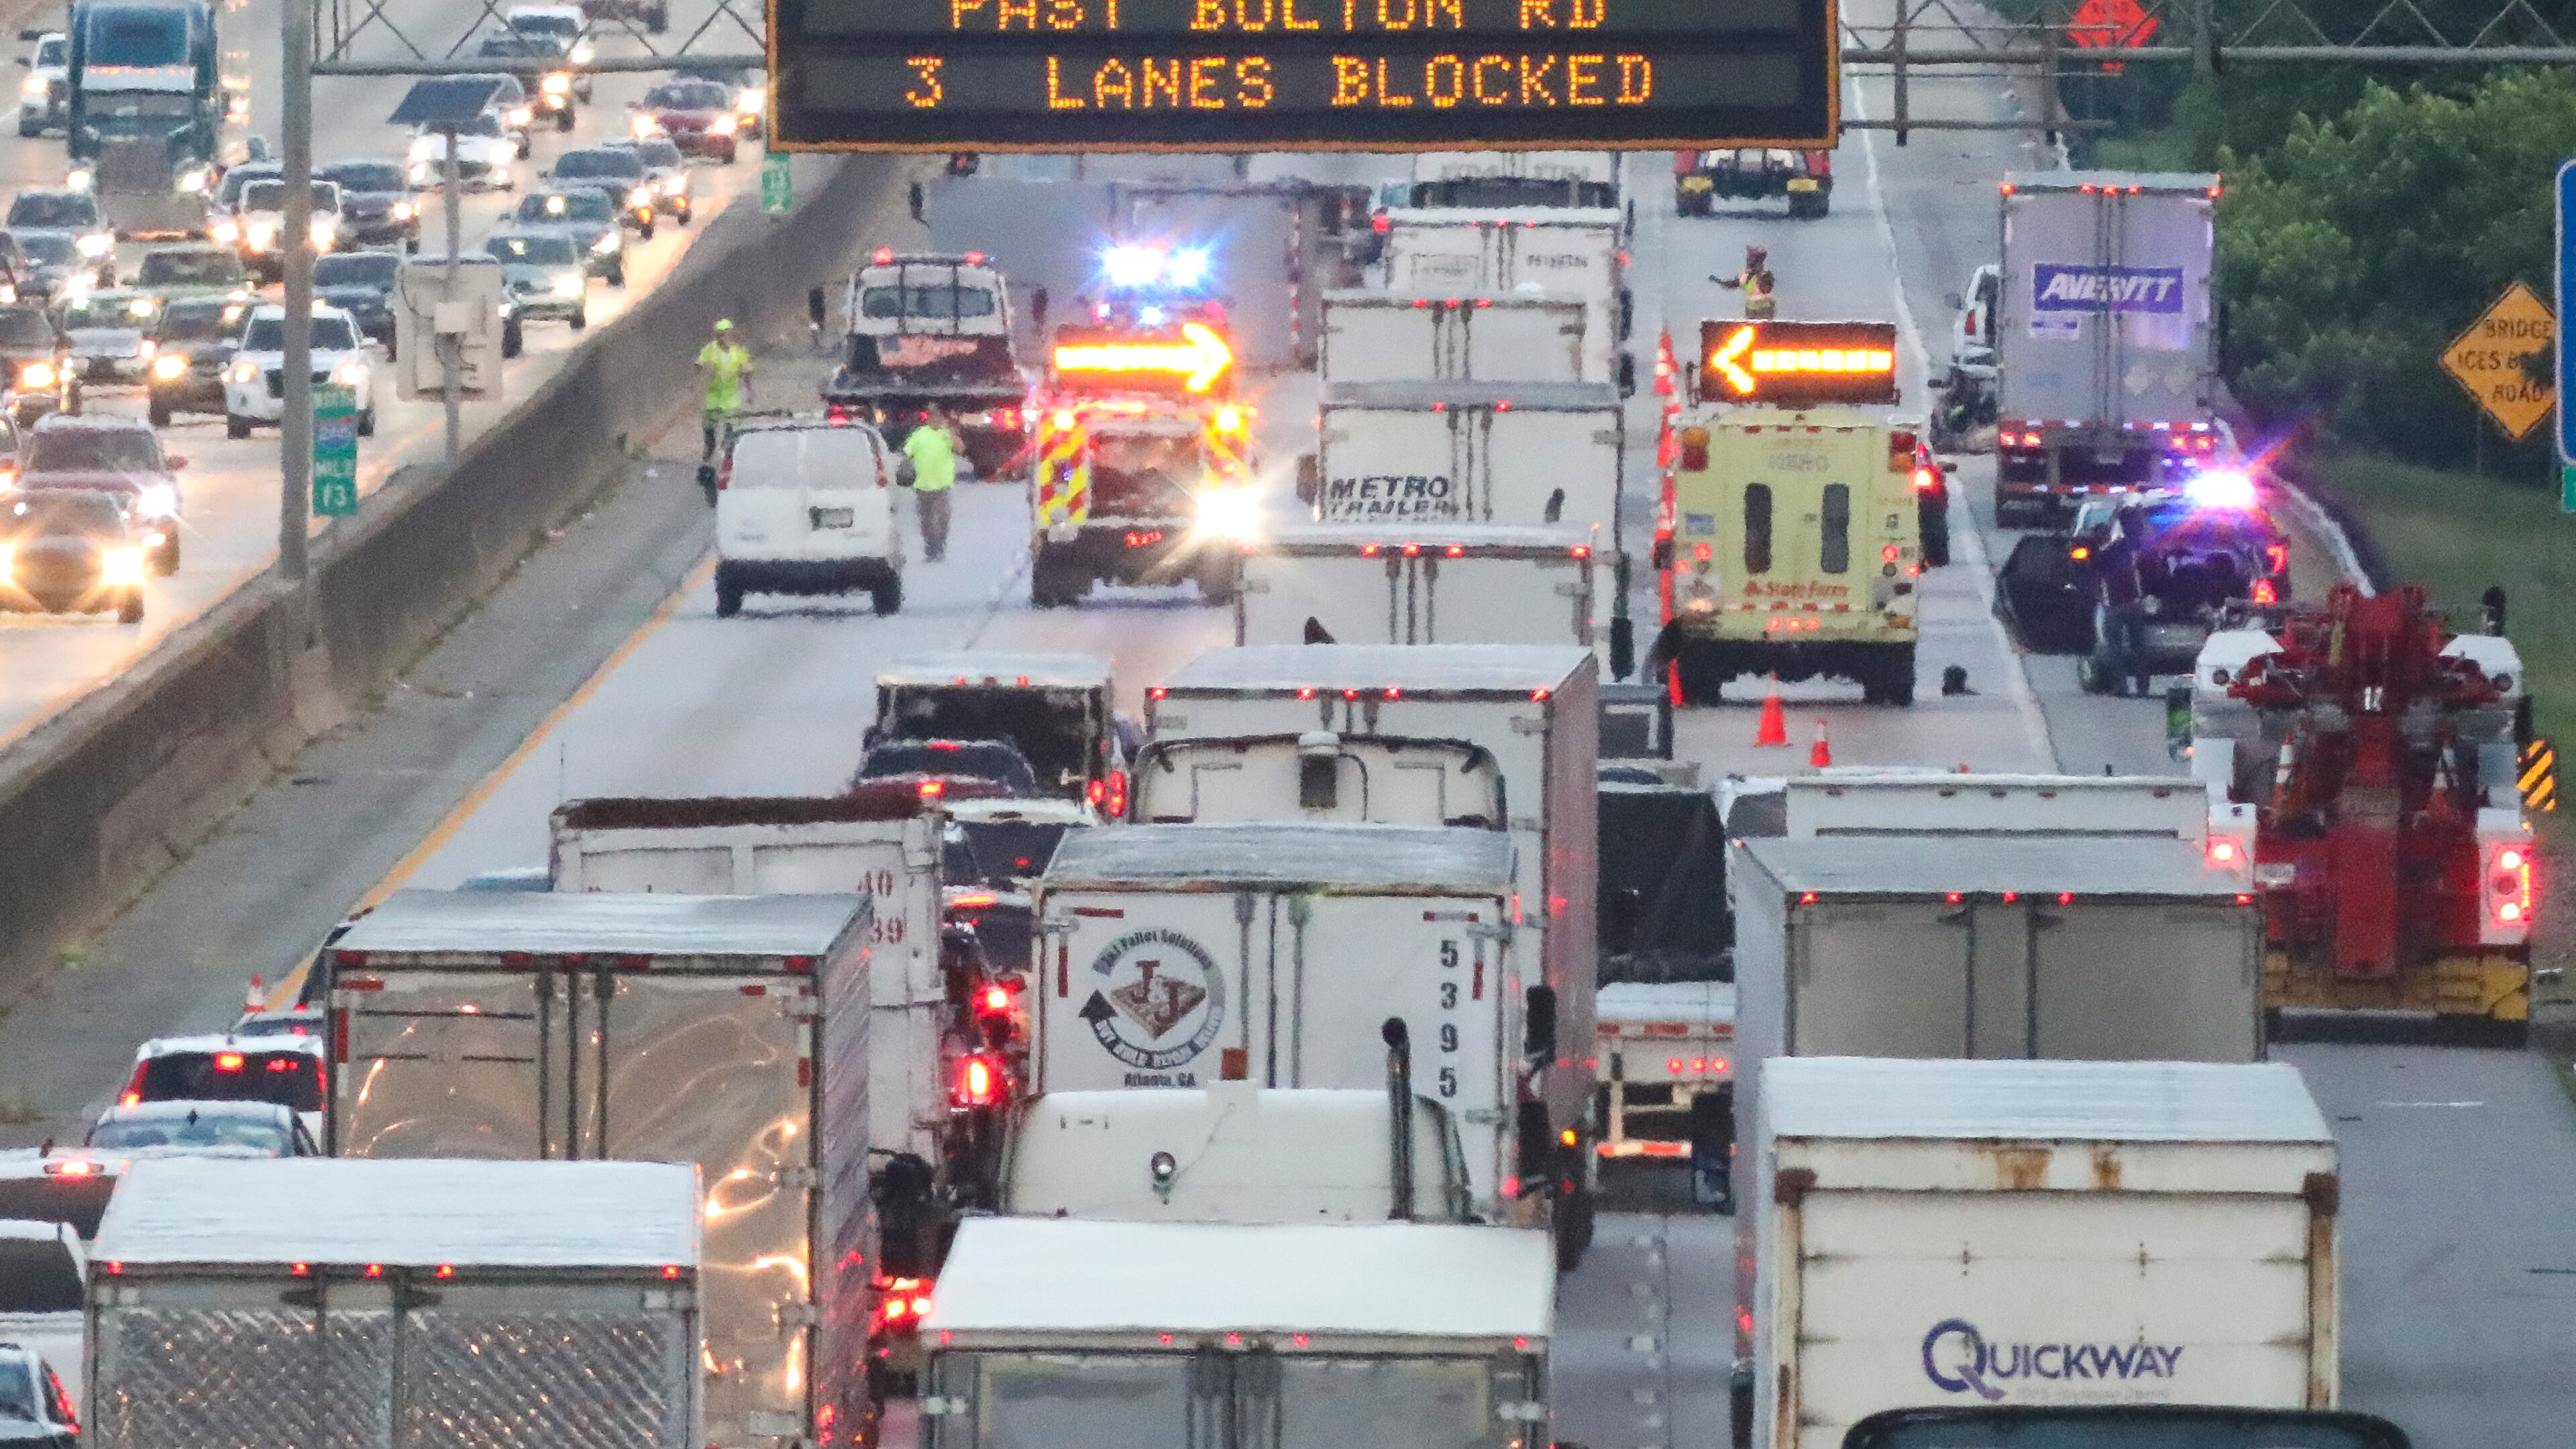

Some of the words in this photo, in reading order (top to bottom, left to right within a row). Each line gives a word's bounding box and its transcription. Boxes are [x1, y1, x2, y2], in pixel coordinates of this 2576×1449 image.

[1189, 0, 1462, 31] BOLTON
[1521, 0, 1605, 30] RD
[905, 55, 945, 109] 3
[1046, 55, 1273, 109] LANES
[1330, 54, 1653, 108] BLOCKED
[2039, 272, 2178, 303] AVERITT
[2484, 318, 2552, 338] BRIDGE
[2457, 350, 2502, 370] ICES
[2491, 381, 2544, 404] ROAD
[1330, 476, 1449, 498] METRO
[1921, 1318, 2186, 1401] QUICKWAY
